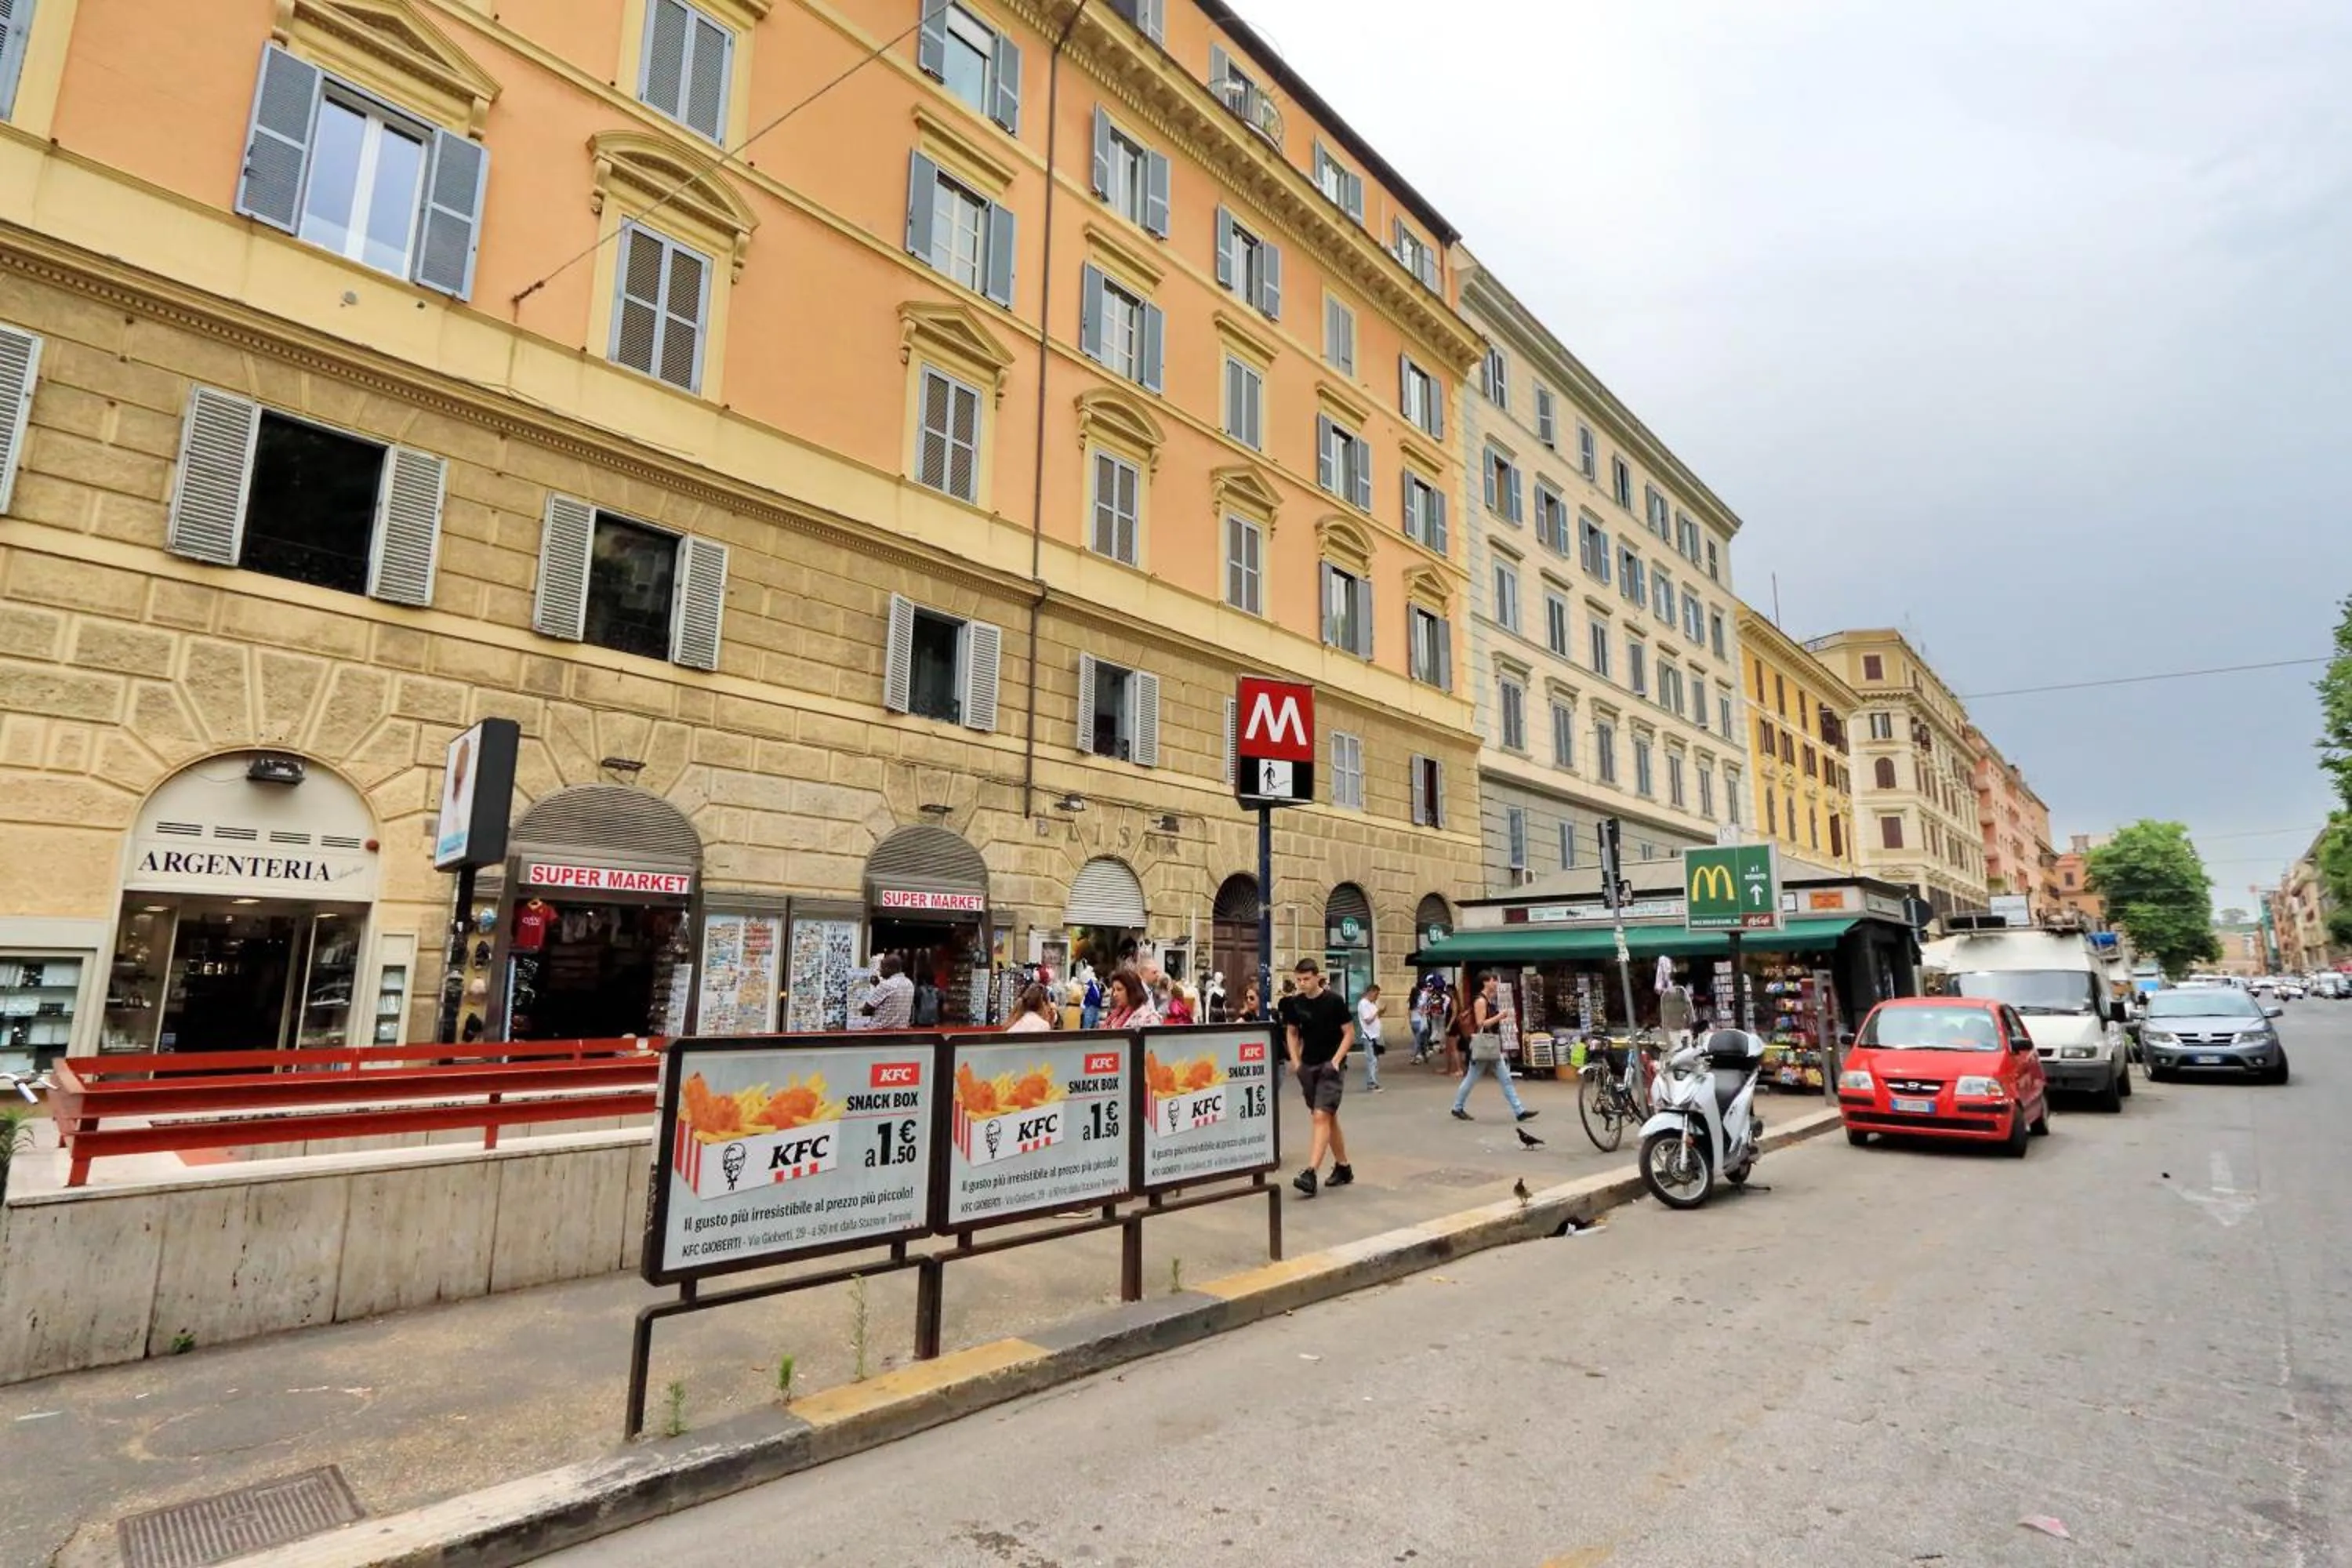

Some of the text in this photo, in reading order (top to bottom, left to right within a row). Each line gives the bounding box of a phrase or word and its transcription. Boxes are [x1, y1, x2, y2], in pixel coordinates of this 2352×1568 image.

[1245, 692, 1308, 746] M
[138, 850, 331, 882] ARGENTERIA
[531, 866, 688, 892] SUPER MARKET
[884, 891, 982, 909] SUPER MARKET
[1091, 1057, 1114, 1069] KFC
[1244, 1048, 1261, 1058] KFC
[879, 1067, 912, 1082] KFC
[1069, 1076, 1120, 1094] SNACK BOX
[846, 1091, 919, 1112] SNACK BOX
[1191, 1094, 1222, 1119] KFC
[1017, 1113, 1058, 1142] KFC
[768, 1134, 830, 1170] KFC
[684, 1185, 914, 1233] Il gusto più irresistibile al prezzo più piccolo!
[682, 1243, 700, 1257] KFC
[701, 1236, 742, 1254] GIOBERTI
